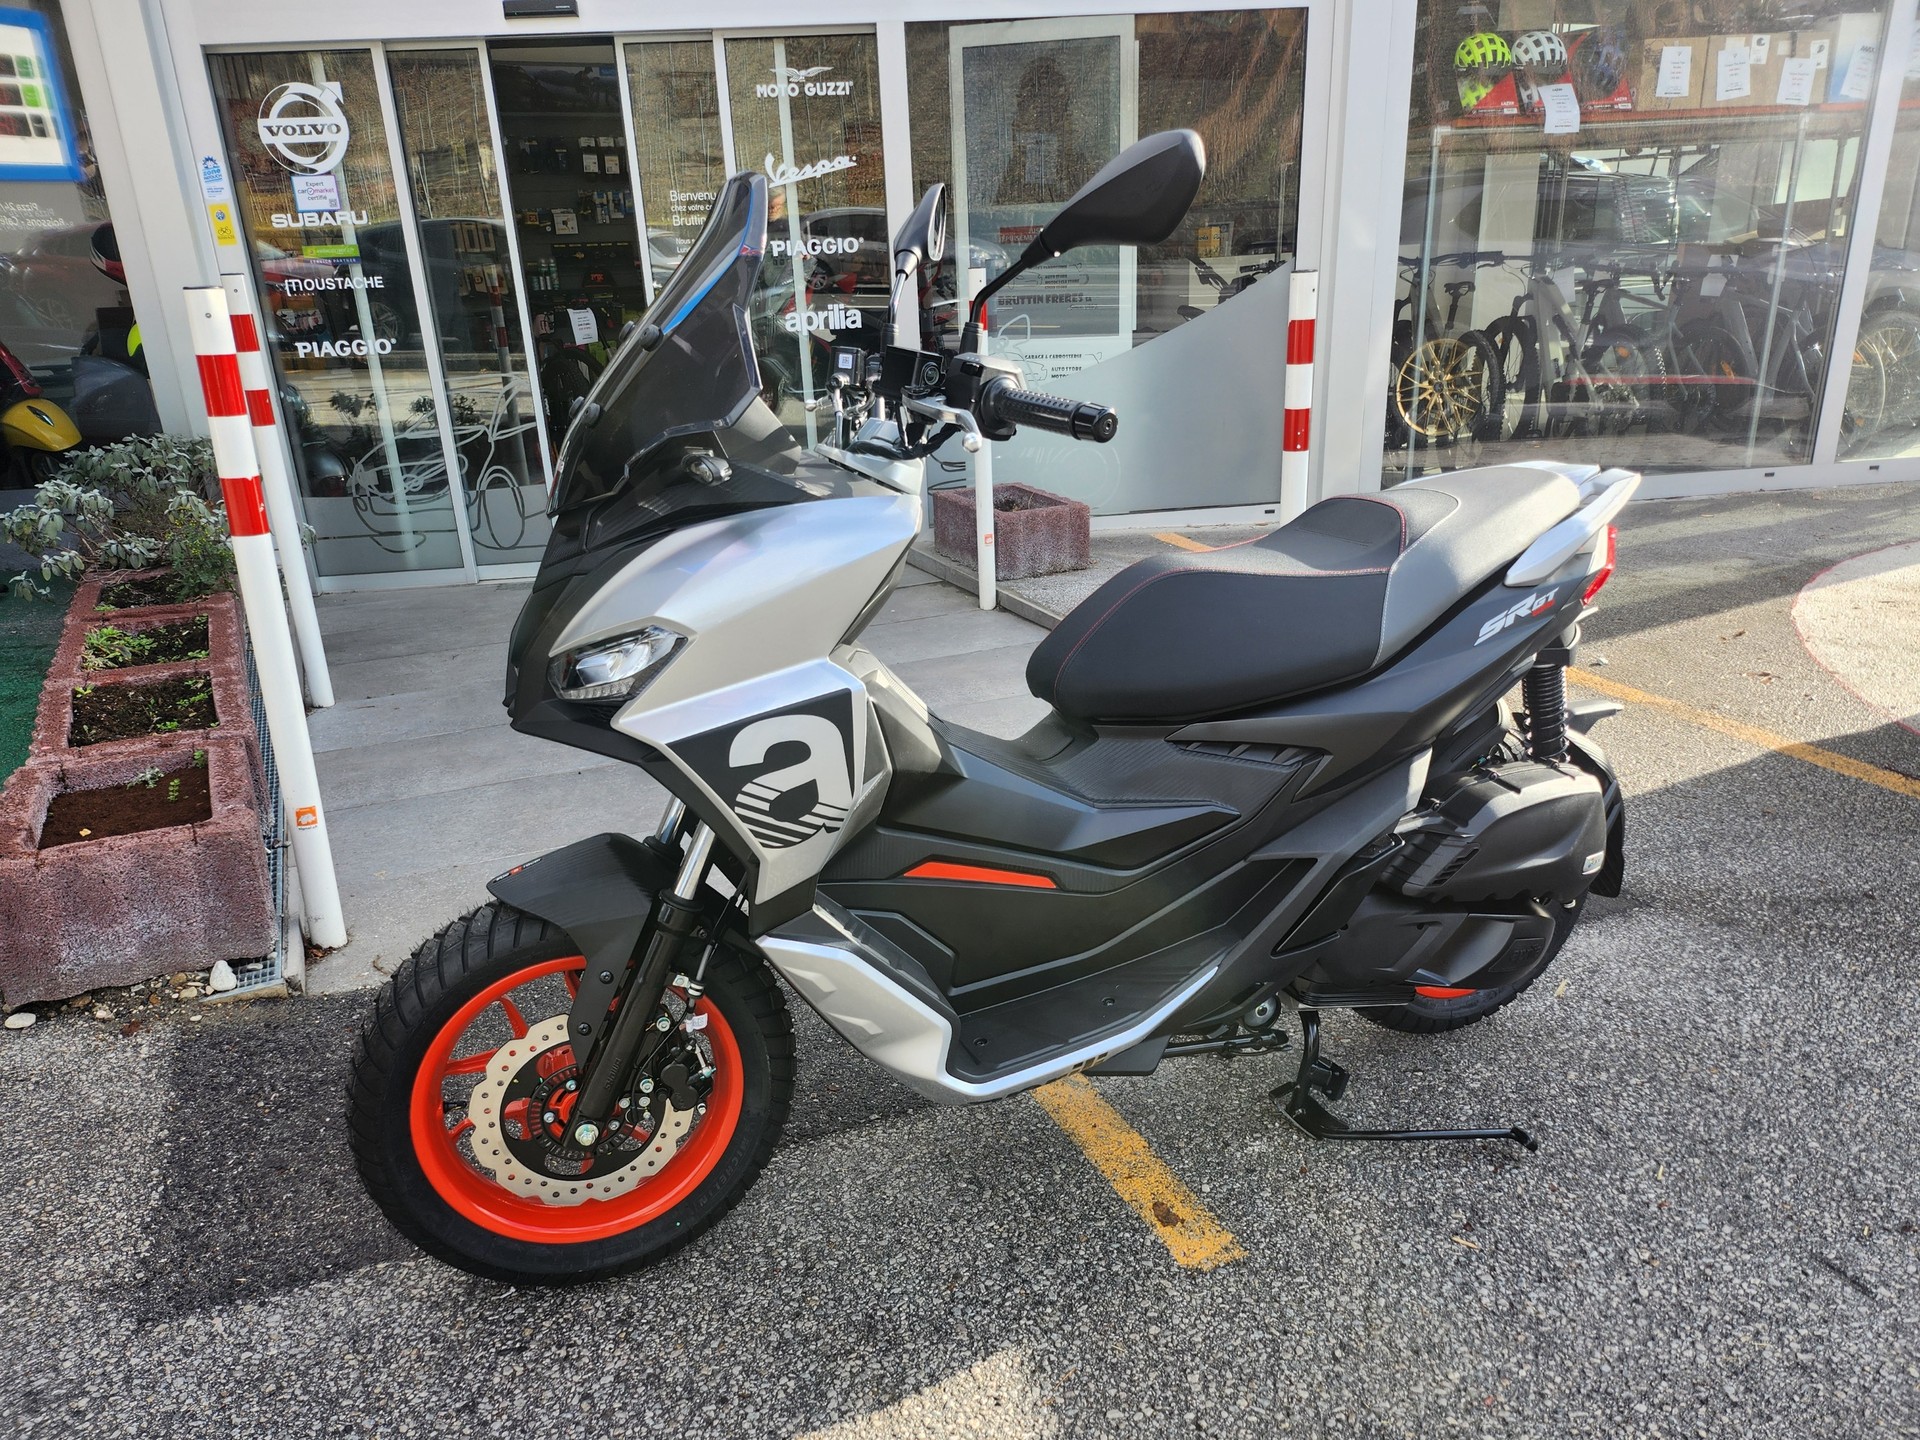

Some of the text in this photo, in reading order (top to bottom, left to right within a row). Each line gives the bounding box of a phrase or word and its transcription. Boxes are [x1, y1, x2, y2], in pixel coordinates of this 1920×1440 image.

[756, 81, 850, 98] MOTO GUZZI
[263, 123, 341, 137] VOLVO
[765, 152, 857, 188] Vespa
[271, 210, 368, 228] SUBARU
[770, 237, 860, 257] PIAGGIO
[284, 276, 385, 296] MOUSTACHE
[997, 294, 1044, 306] BRUTTIN
[785, 303, 863, 336] aprilia
[294, 338, 393, 358] PIAGGIO
